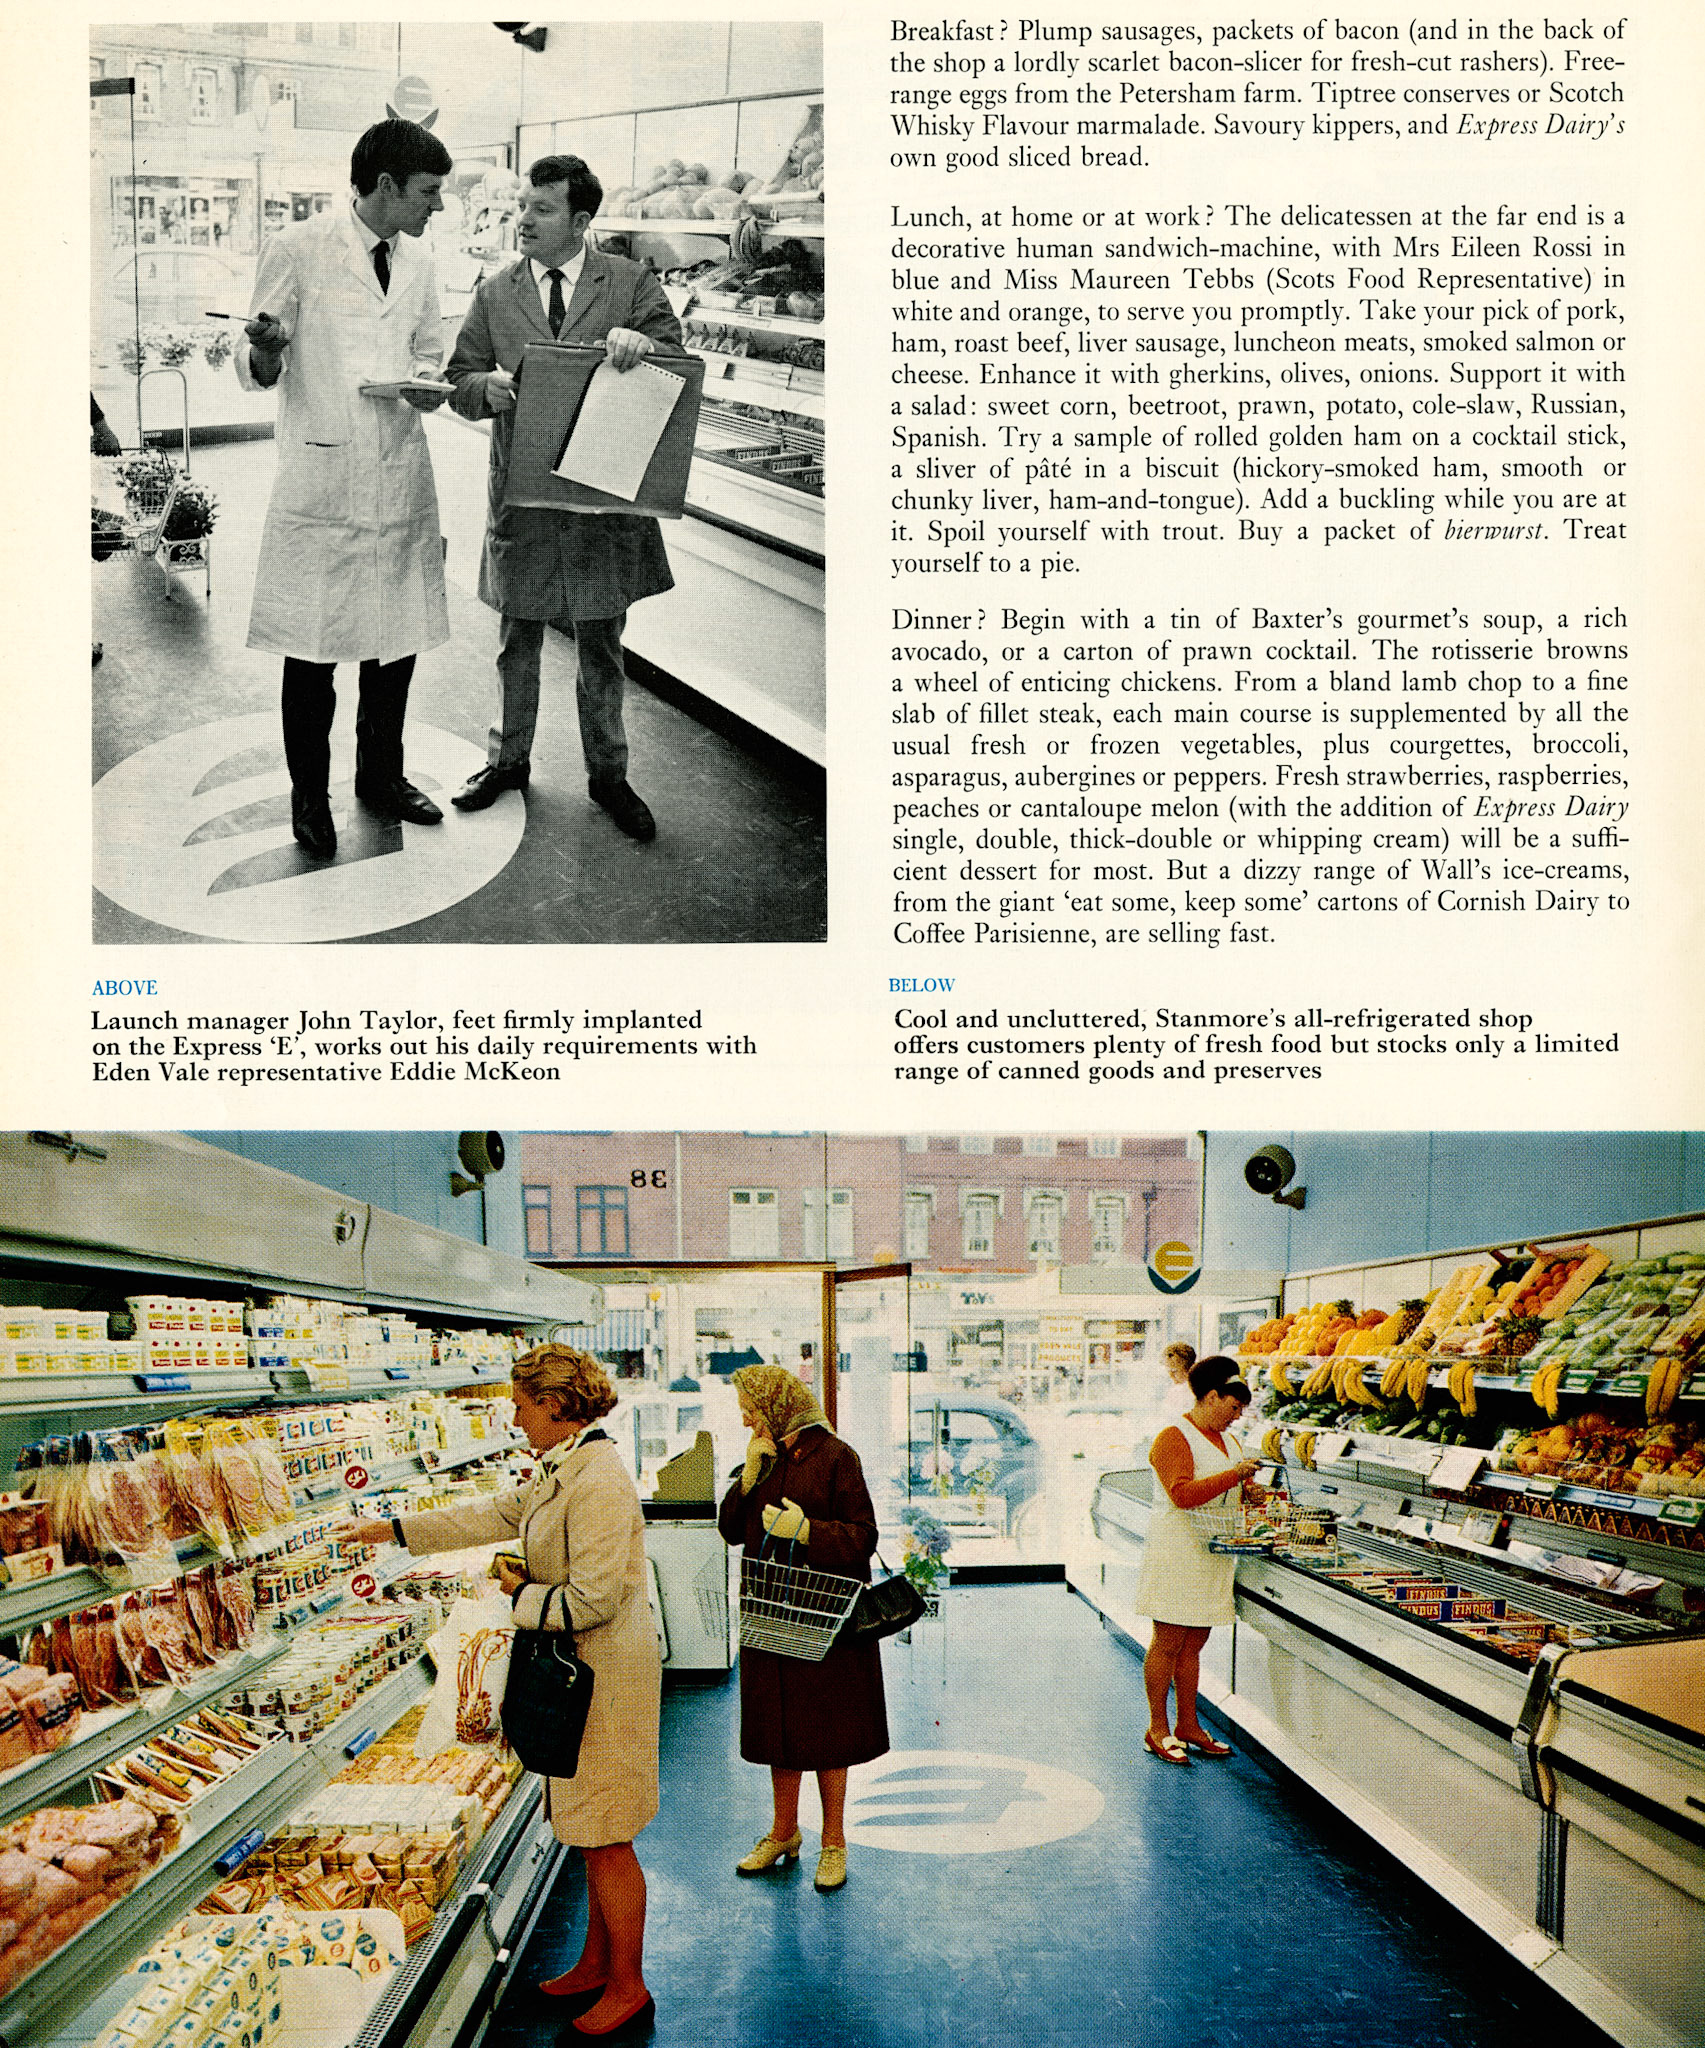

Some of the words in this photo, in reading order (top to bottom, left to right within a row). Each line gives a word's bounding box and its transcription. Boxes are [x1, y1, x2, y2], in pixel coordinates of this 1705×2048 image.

[1019, 19, 1092, 47] Plump
[1102, 26, 1202, 46] sausages,
[1213, 19, 1293, 46] packets
[1303, 19, 1327, 39] of
[1335, 19, 1399, 39] bacon
[1410, 18, 1457, 45] (and
[1468, 19, 1488, 39] in
[1499, 19, 1533, 39] the
[1544, 18, 1594, 39] back
[1604, 18, 1628, 39] of
[891, 52, 925, 72] the
[934, 51, 985, 78] shop
[995, 58, 1005, 71] a
[1014, 51, 1080, 78] lordly
[1089, 51, 1159, 71] scarlet
[1169, 50, 1302, 71] bacon-slicer
[1312, 50, 1342, 71] for
[1352, 50, 1451, 71] fresh-cut
[1460, 50, 1553, 77] rashers).
[1564, 50, 1625, 70] Free-
[890, 114, 975, 141] Whisky
[983, 114, 1069, 135] Flavour
[1077, 113, 1205, 134] marmalade.
[1215, 113, 1305, 140] Savoury
[1313, 113, 1400, 141] kippers,
[1408, 114, 1447, 134] and
[1456, 114, 1538, 140] Express
[891, 153, 936, 167] own
[947, 146, 999, 173] good
[1009, 145, 1070, 166] sliced
[1081, 145, 1148, 166] bread.
[891, 206, 971, 231] Lunch,
[982, 211, 1001, 226] at
[1012, 206, 1072, 226] home
[1083, 213, 1105, 226] or
[1115, 210, 1135, 226] at
[1225, 205, 1270, 225] The
[1281, 204, 1412, 225] delicatessen
[1422, 210, 1442, 225] at
[1452, 205, 1486, 225] the
[1497, 204, 1527, 225] far
[1537, 204, 1576, 225] end
[1588, 204, 1604, 225] is
[1614, 211, 1625, 224] a
[892, 237, 1005, 258] decorative
[1017, 237, 1093, 258] human
[1106, 236, 1319, 262] sandwich-machine,
[1333, 236, 1380, 257] with
[1393, 236, 1439, 257] Mrs
[1451, 236, 1520, 257] Eileen
[1533, 236, 1592, 257] Rossi
[1604, 236, 1625, 256] in
[1001, 608, 1065, 635] Begin
[1081, 608, 1129, 629] with
[1145, 615, 1155, 628] a
[1171, 608, 1200, 628] tin
[1216, 608, 1240, 628] of
[1484, 615, 1542, 635] soup,
[1558, 614, 1568, 627] a
[1584, 607, 1627, 627] rich
[893, 797, 979, 824] peaches
[989, 804, 1011, 817] or
[1021, 796, 1141, 823] cantaloupe
[1152, 796, 1219, 817] melon
[1230, 796, 1286, 823] (with
[1297, 796, 1331, 816] the
[1341, 796, 1432, 817] addition
[1442, 796, 1467, 817] of
[1473, 796, 1555, 823] Express
[1565, 795, 1629, 822] Dairy
[894, 922, 965, 943] Coffee
[975, 922, 1096, 948] Parisienne,
[1106, 929, 1139, 942] are
[1149, 922, 1220, 948] selling
[1230, 921, 1274, 942] fast.
[93, 980, 157, 995] ABOVE
[889, 978, 955, 992] BELOW
[91, 1010, 178, 1029] Launch
[187, 1017, 289, 1035] manager
[296, 1010, 351, 1035] John
[360, 1010, 443, 1034] Taylor,
[453, 1010, 495, 1029] feet
[504, 1010, 574, 1034] firmly
[583, 1009, 702, 1034] implanted
[895, 1009, 947, 1028] Cool
[957, 1009, 998, 1028] and
[1007, 1008, 1146, 1032] uncluttered,
[1295, 1008, 1470, 1032] all-refrigerated
[1480, 1008, 1532, 1032] shop
[93, 1043, 120, 1055] on
[129, 1036, 164, 1055] the
[173, 1036, 261, 1060] Express
[315, 1036, 381, 1055] works
[390, 1040, 427, 1055] out
[436, 1036, 468, 1054] his
[478, 1036, 534, 1060] daily
[543, 1035, 697, 1059] requirements
[706, 1035, 757, 1054] with
[894, 1035, 958, 1054] offers
[967, 1039, 1084, 1053] customers
[1094, 1034, 1165, 1058] plenty
[1175, 1034, 1199, 1053] of
[1206, 1034, 1262, 1053] fresh
[1272, 1034, 1321, 1053] food
[1331, 1034, 1369, 1053] but
[1378, 1034, 1446, 1053] stocks
[1456, 1034, 1504, 1058] only
[1514, 1041, 1526, 1053] a
[1535, 1033, 1619, 1052] limited
[93, 1062, 150, 1081] Eden
[158, 1062, 209, 1081] Vale
[218, 1062, 381, 1086] representative
[390, 1061, 455, 1080] Eddie
[464, 1062, 560, 1080] McKeon
[895, 1067, 958, 1084] range
[967, 1060, 992, 1079] of
[999, 1060, 1080, 1079] canned
[1089, 1060, 1154, 1084] goods
[1163, 1060, 1205, 1079] and
[1214, 1066, 1321, 1084] preserves
[1410, 1590, 1446, 1600] FINDUS
[1455, 1603, 1493, 1617] FINDUS
